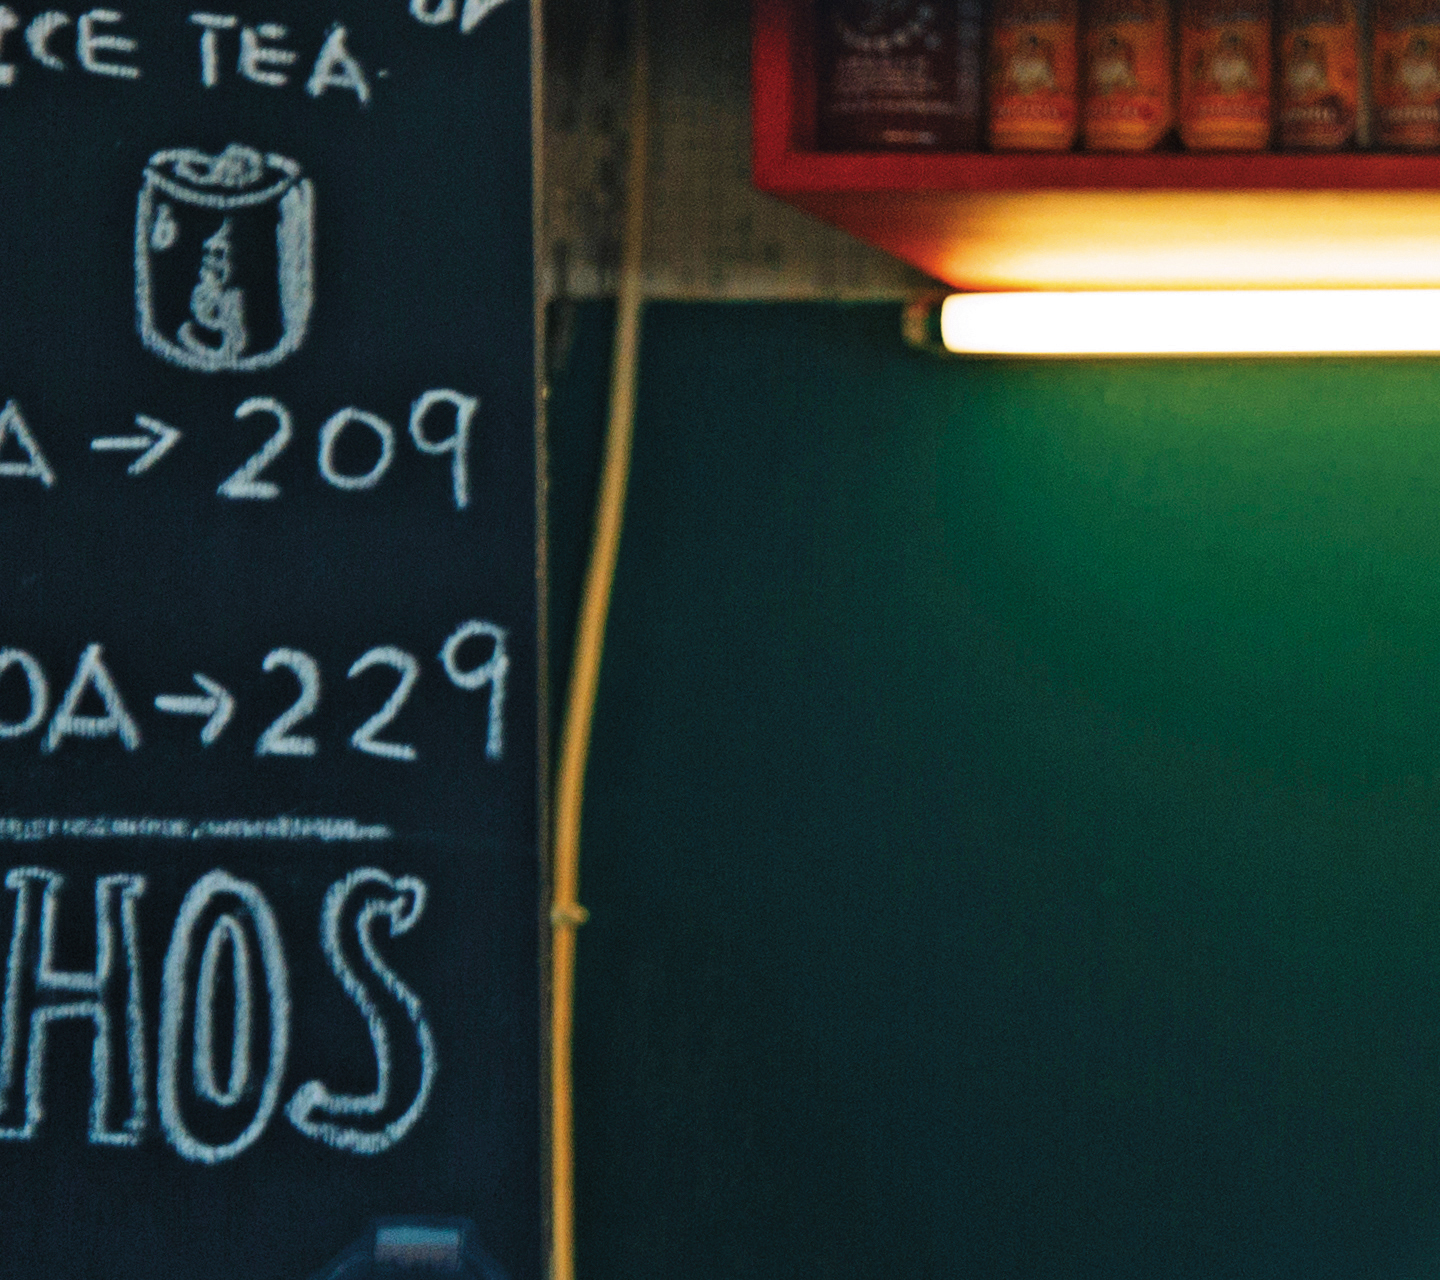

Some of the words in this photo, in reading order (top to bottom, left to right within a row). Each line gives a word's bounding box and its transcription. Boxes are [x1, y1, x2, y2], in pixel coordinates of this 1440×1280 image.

[190, 12, 370, 104] TEA
[217, 387, 479, 510] 209
[257, 619, 509, 761] 229
[0, 867, 438, 1165] HOS
